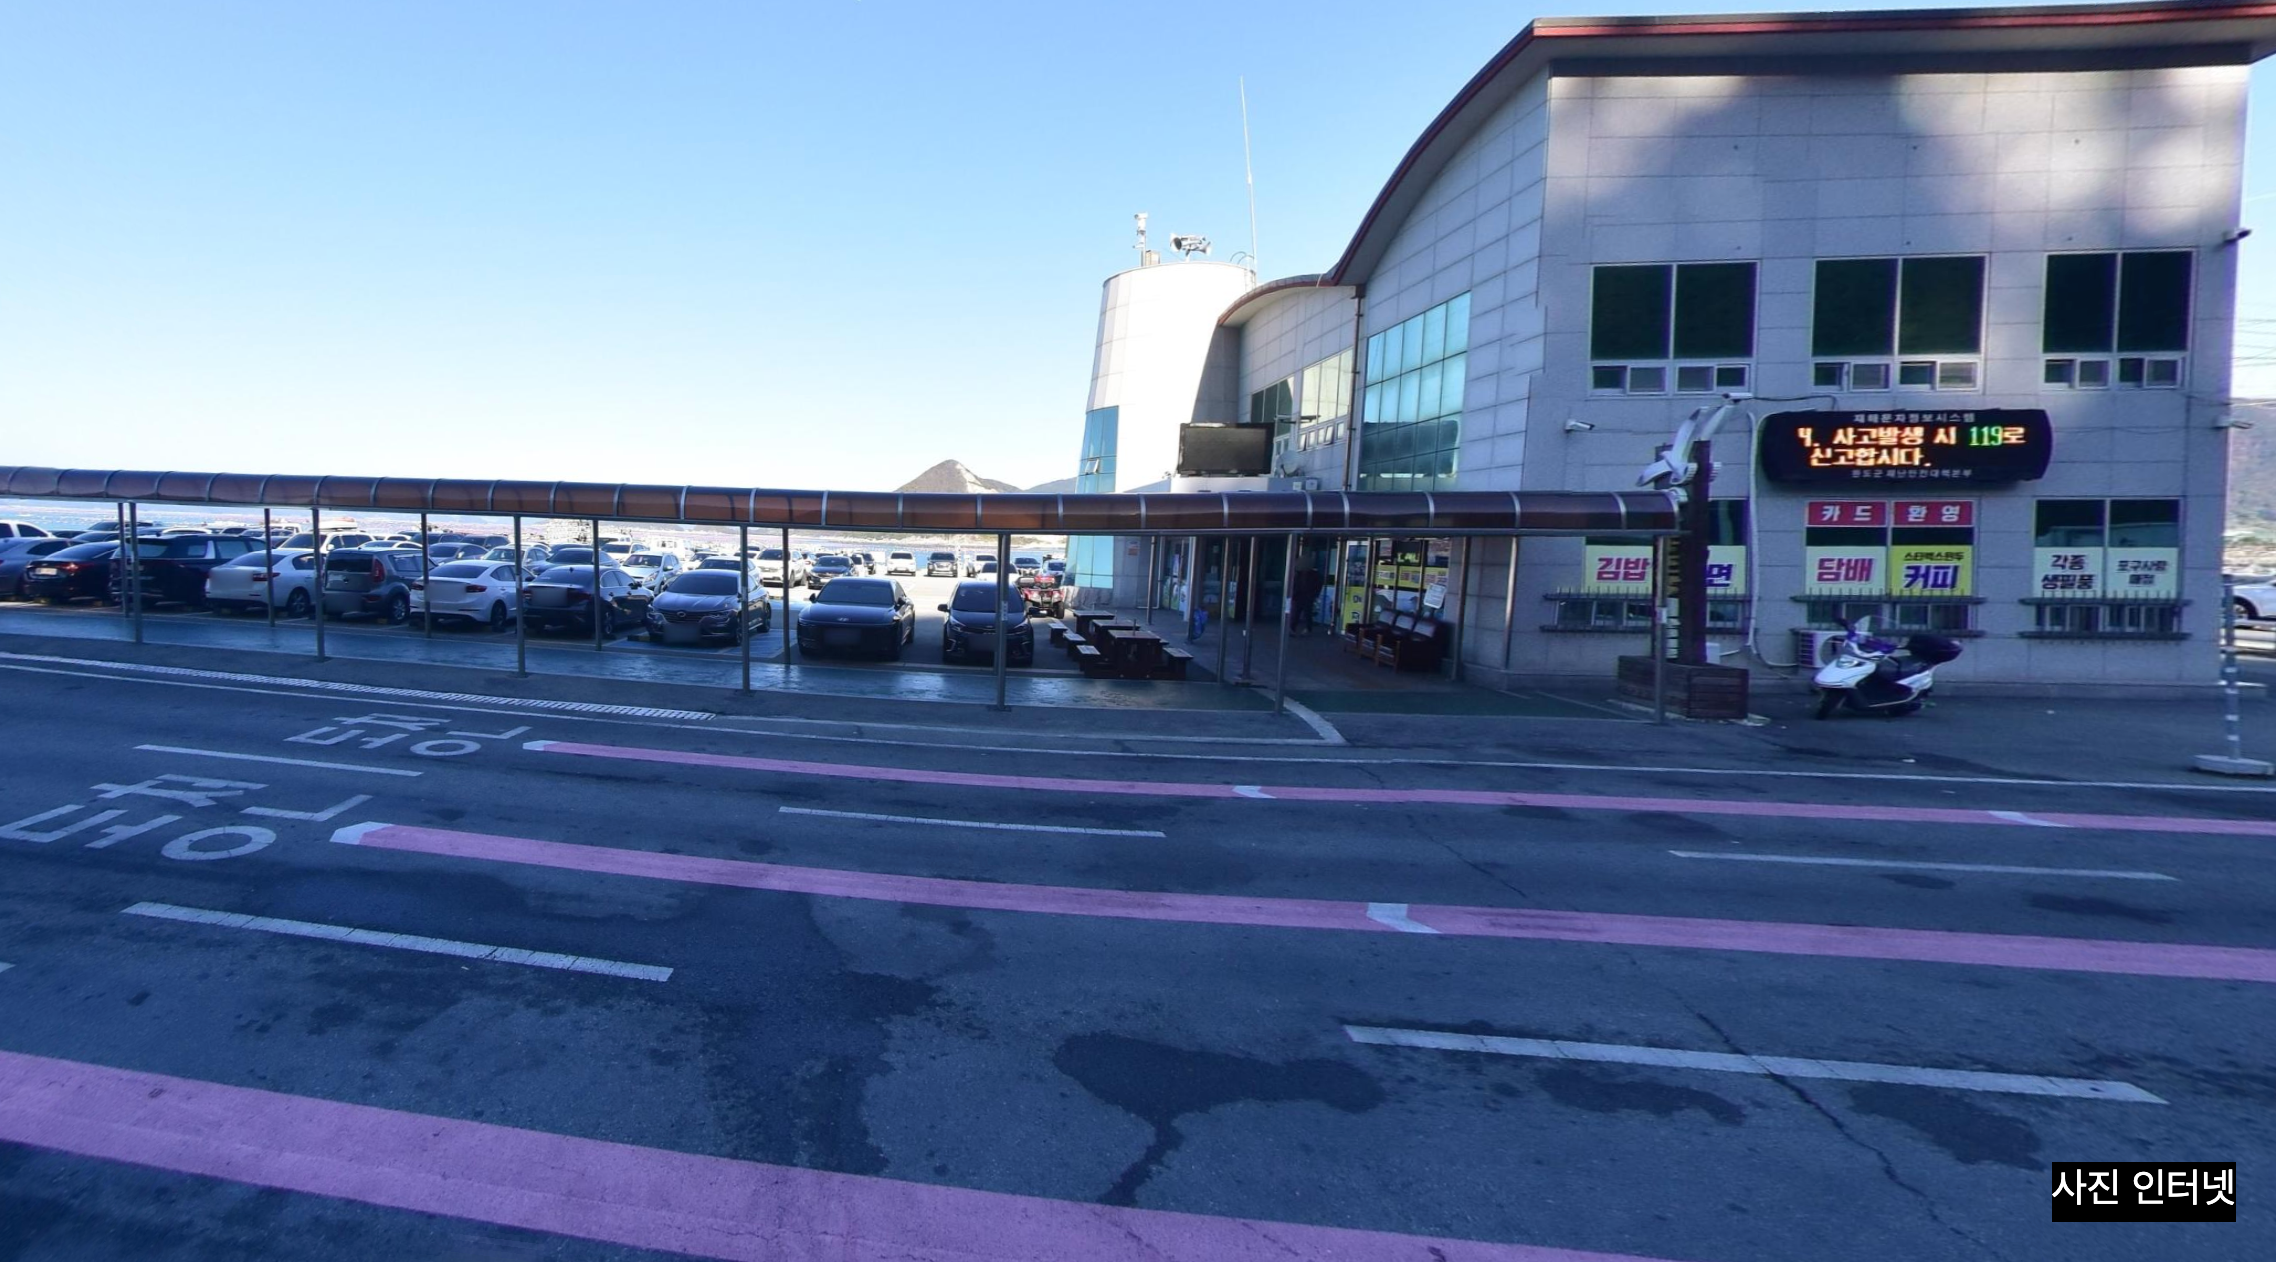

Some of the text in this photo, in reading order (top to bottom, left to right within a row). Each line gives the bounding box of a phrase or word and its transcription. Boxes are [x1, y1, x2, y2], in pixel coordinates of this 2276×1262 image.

[1832, 427, 1924, 446] 사고발생
[1933, 427, 1957, 445] 시
[1969, 426, 2027, 446] 119로
[1810, 447, 1932, 467] 신고합시다.
[1596, 557, 1651, 582] 김밥
[1817, 558, 1874, 582] 담배
[2051, 554, 2086, 570] 각종
[1904, 565, 1960, 590] 커피
[2041, 574, 2095, 590] 생필품
